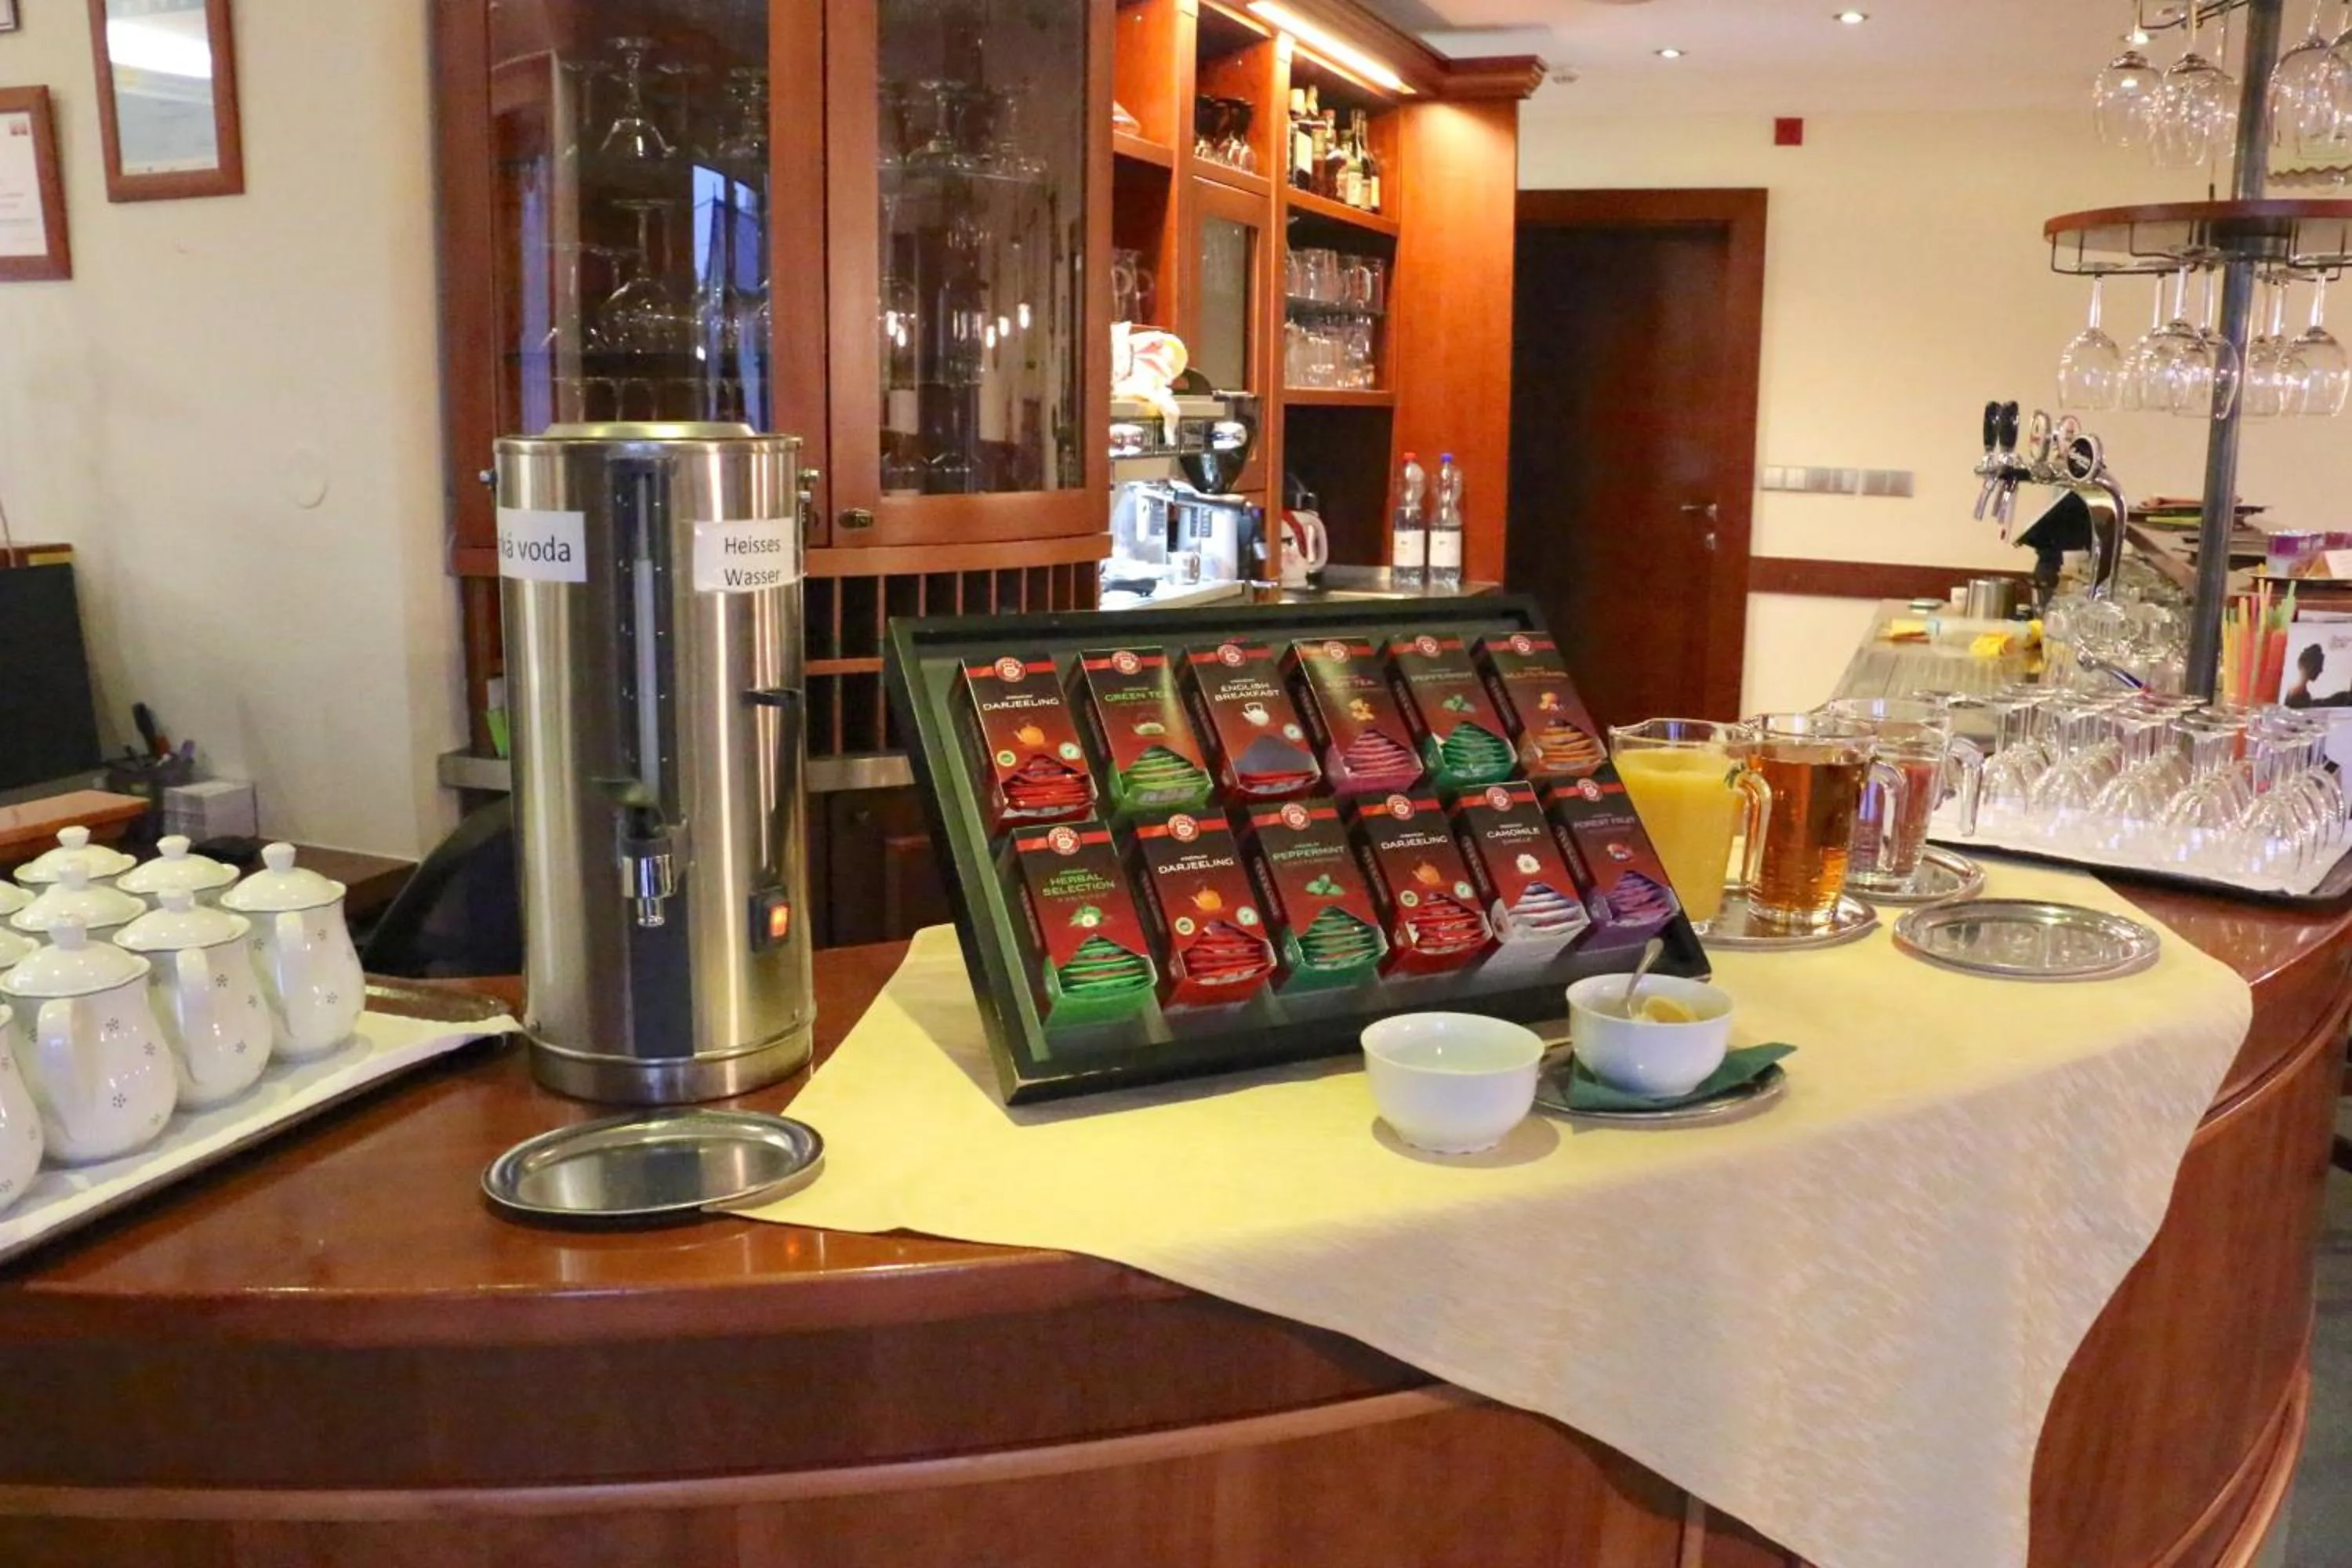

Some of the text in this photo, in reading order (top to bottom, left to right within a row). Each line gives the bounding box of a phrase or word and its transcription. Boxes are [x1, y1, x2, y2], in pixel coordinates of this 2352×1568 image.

[518, 533, 571, 562] voda
[724, 535, 781, 554] Heisses
[724, 568, 780, 586] Wasser
[1221, 683, 1270, 692] ENGLISH
[1104, 692, 1145, 702] GREEN
[1214, 689, 1280, 702] BREAKFAST
[982, 697, 1059, 711] DARJEELING
[1486, 827, 1541, 838] CAMOMILE
[1381, 835, 1448, 849] DARJEELING
[1272, 846, 1345, 861] PEPPERMINT
[1158, 857, 1234, 874] DARJEELING
[1050, 873, 1103, 885] HERBAL
[1042, 880, 1116, 896] SELECTION
